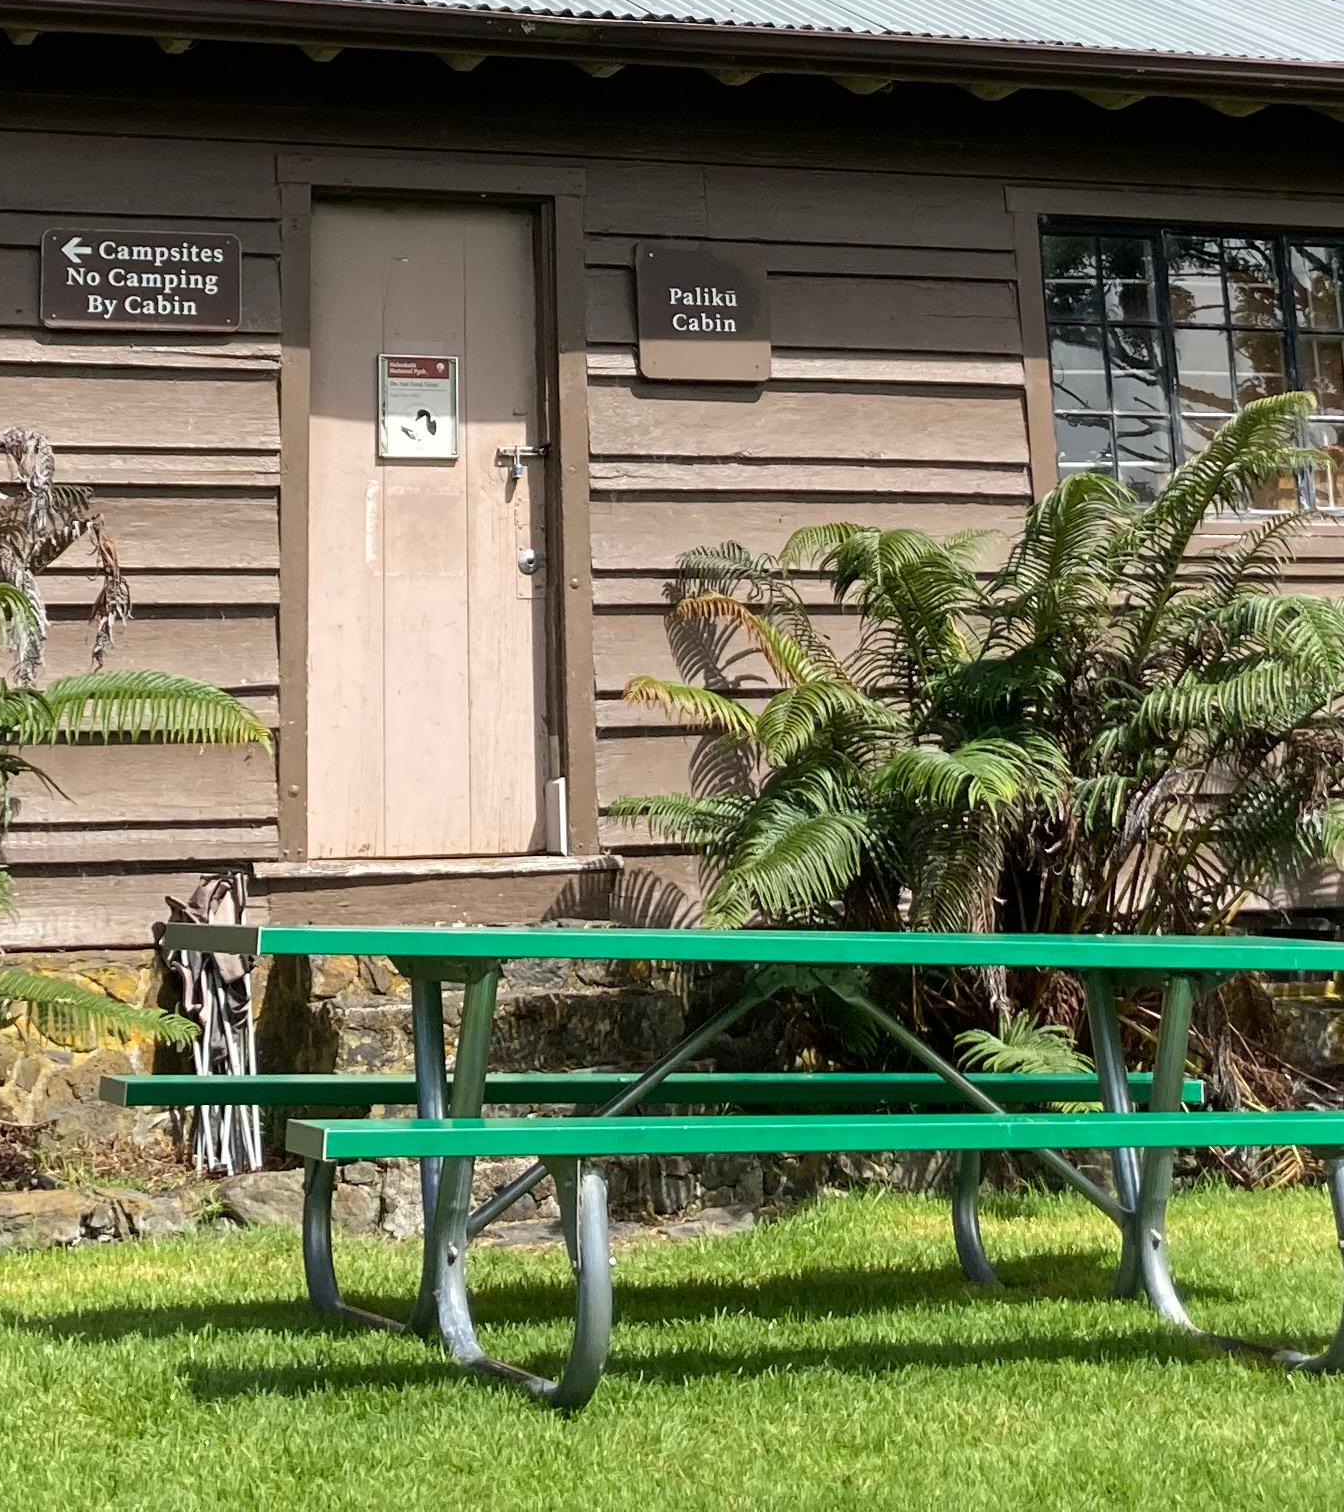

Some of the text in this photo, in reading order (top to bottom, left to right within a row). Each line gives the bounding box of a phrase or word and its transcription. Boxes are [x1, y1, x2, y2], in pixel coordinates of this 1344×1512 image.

[98, 241, 223, 266] Campsites
[66, 268, 219, 294] No Camping
[87, 295, 197, 319] By Cabin
[669, 287, 737, 307] Palikū
[673, 313, 736, 332] Cabin
